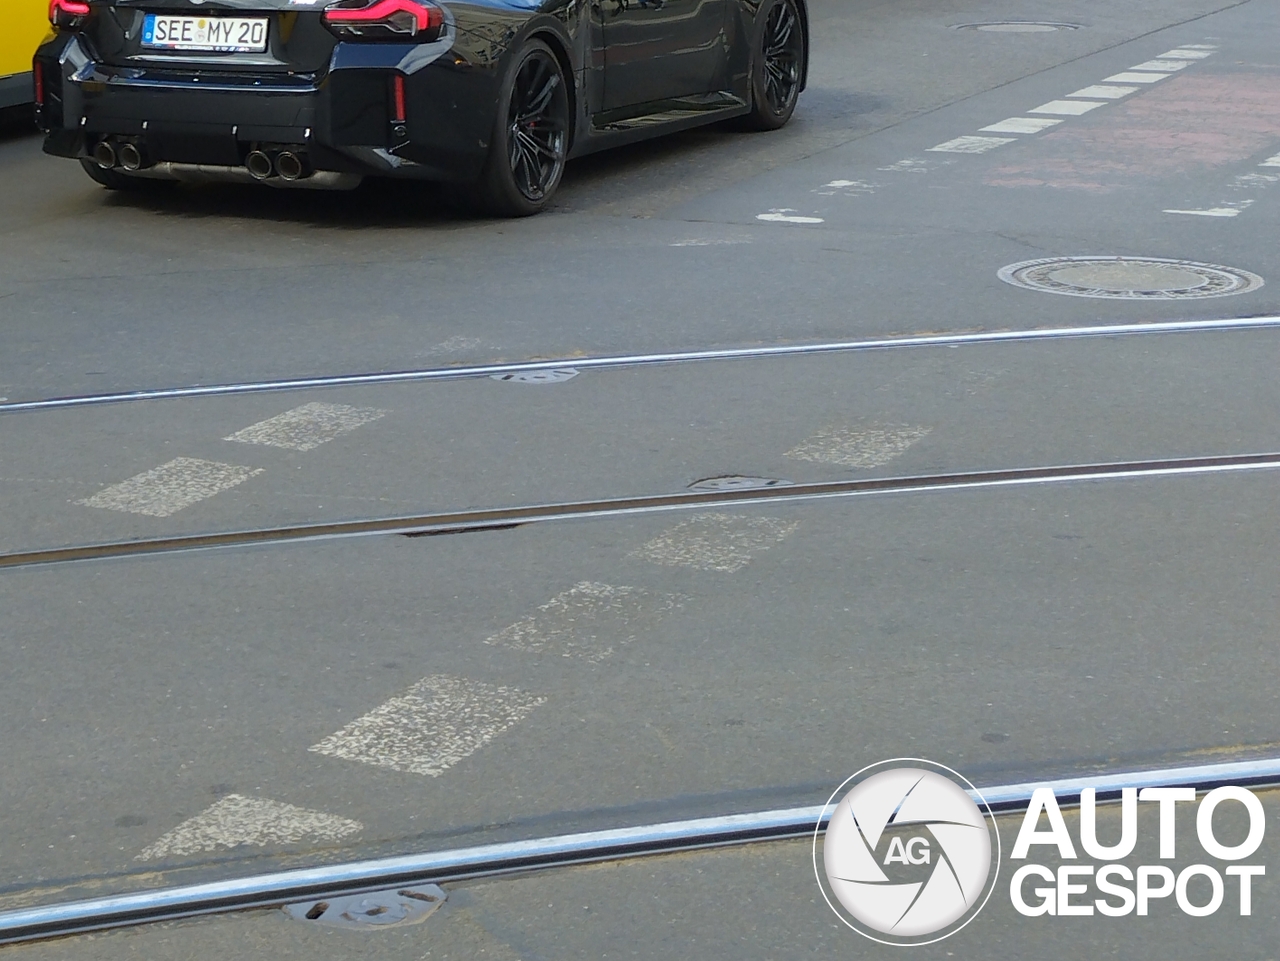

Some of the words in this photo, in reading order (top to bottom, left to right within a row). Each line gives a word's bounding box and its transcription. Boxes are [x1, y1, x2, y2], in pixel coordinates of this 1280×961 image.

[155, 19, 194, 42] SEE
[207, 21, 234, 43] MY
[237, 22, 263, 44] 20
